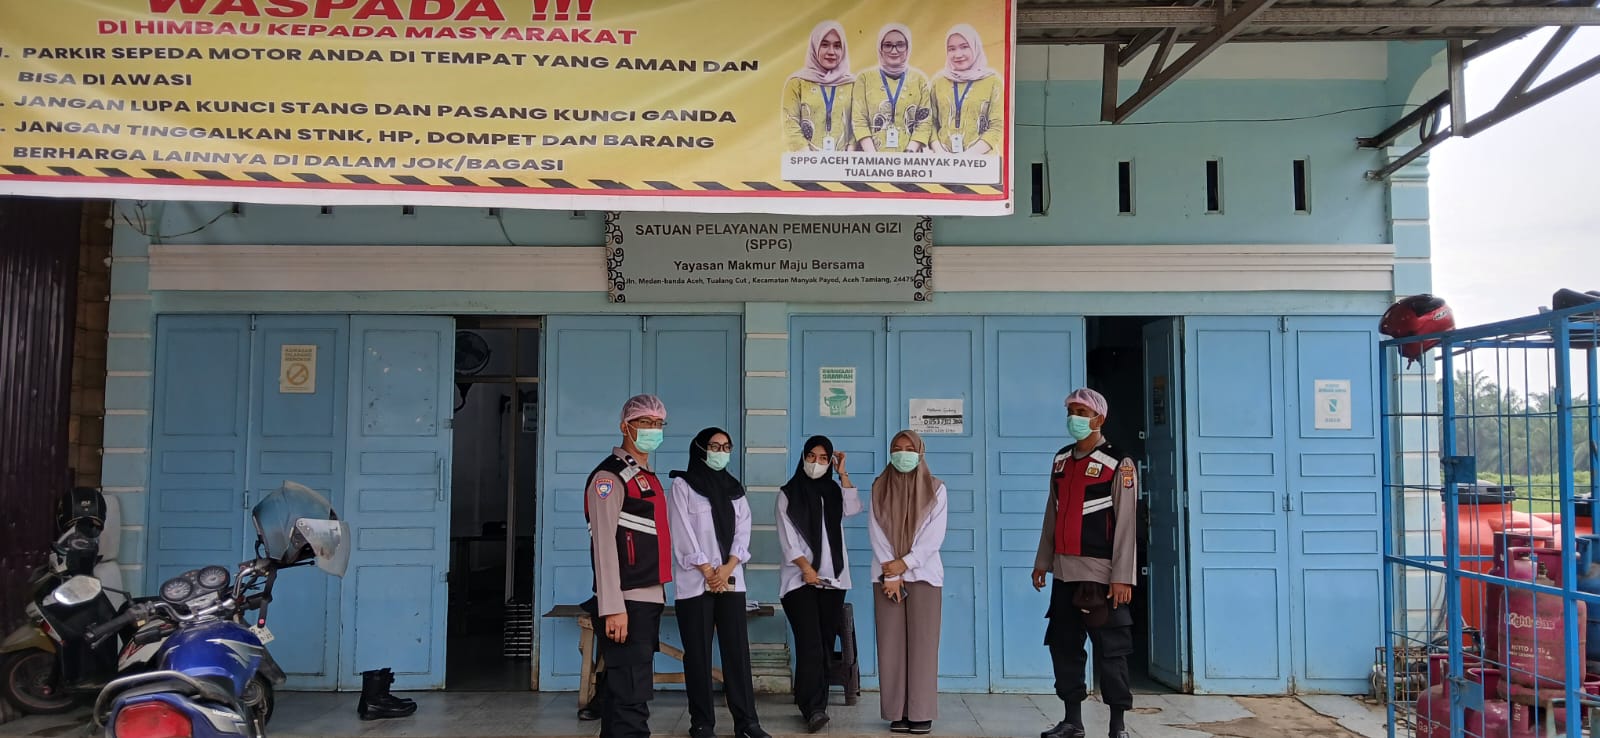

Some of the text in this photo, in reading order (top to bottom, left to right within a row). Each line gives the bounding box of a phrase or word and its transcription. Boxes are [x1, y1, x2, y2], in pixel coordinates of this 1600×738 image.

[98, 20, 637, 44] DI HIMBAU KEPADA MASYARAKAT
[22, 47, 106, 60] PARKIR
[111, 48, 202, 60] SEPEDA
[208, 48, 302, 61] MOTOR
[307, 49, 384, 63] ANDA
[390, 50, 415, 63] DI
[421, 51, 526, 67] TEMPAT
[533, 54, 609, 69] YANG
[615, 57, 696, 72] AMAN
[703, 60, 759, 73] DAN
[17, 71, 192, 86] BISA DI AWASI
[14, 95, 737, 124] JANGAN LUPA KUNCI STANG DAN PASANG KUNCI GANDA
[14, 120, 715, 149] JANGAN TINGGALKAN STNK, HP, DOMPET DAN BARANG
[13, 147, 563, 172] BERHARGA LAINNYA DI DALAM JOK/BAGASI
[790, 156, 987, 168] SPPG ACEH TAMIANG MANYAK PAYED
[845, 168, 933, 178] TUALANG BARO 1
[635, 222, 901, 235] SATUAN PELAYANAN PEMENUHAN GIZI
[745, 238, 792, 252] (SPPG)
[674, 259, 865, 272] Yayasan Makmur Maju Bersama
